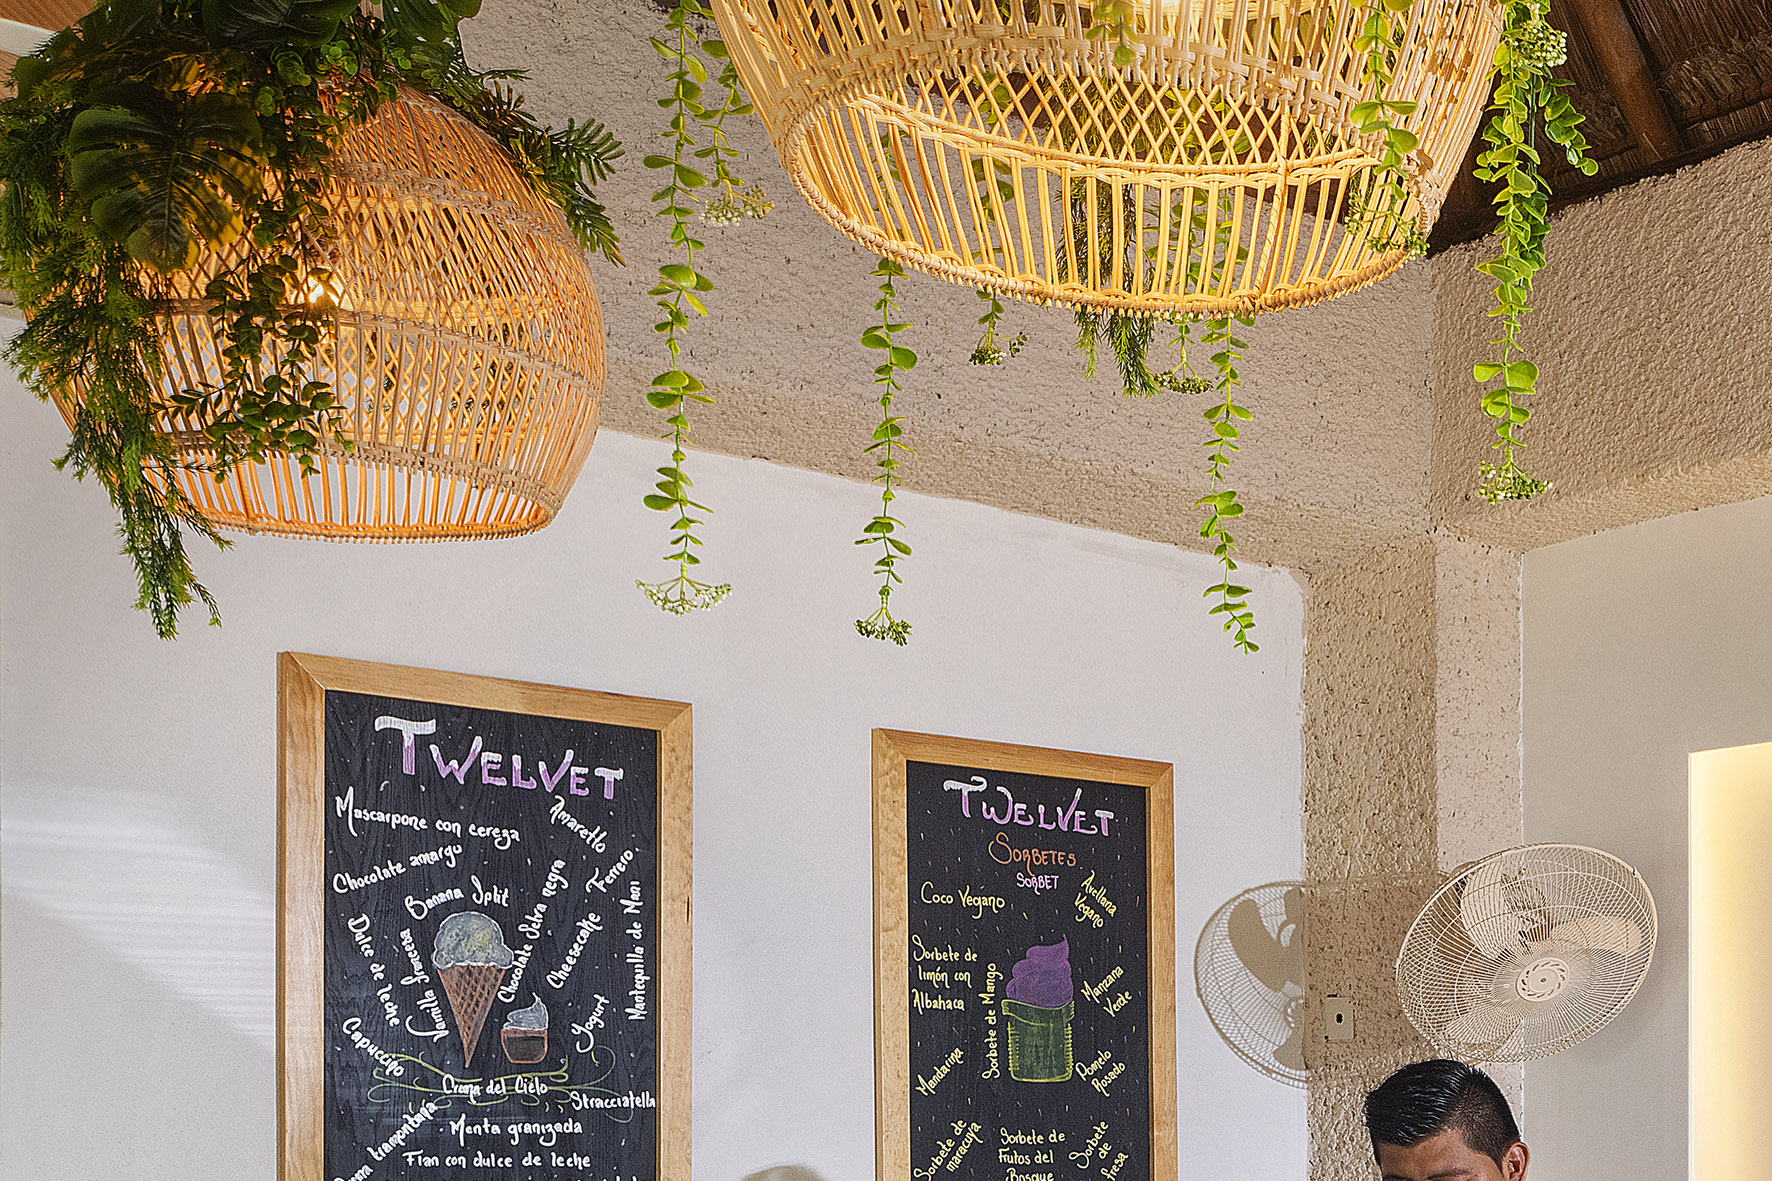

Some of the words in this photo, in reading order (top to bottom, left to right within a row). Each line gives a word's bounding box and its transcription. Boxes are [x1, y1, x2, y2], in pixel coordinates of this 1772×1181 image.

[375, 716, 623, 800] TWELVET
[335, 786, 428, 837] Mascarpone
[435, 819, 461, 838] con
[549, 795, 607, 853] Amaretto
[943, 776, 1114, 836] TWELVET
[333, 860, 406, 894] Chocolate
[585, 850, 634, 893] Ferrero
[1016, 872, 1059, 895] SORBET
[404, 888, 464, 920] Banana
[471, 874, 509, 907] Split
[921, 881, 954, 904] Coco
[958, 885, 1005, 919] Vegano
[1074, 892, 1104, 929] Vegano
[1081, 869, 1117, 917] Avellana
[347, 913, 374, 957] Dulce
[497, 944, 533, 1003] Chocolate
[518, 903, 548, 939] Selva
[541, 859, 568, 897] negra
[625, 921, 642, 940] de
[912, 934, 960, 961] Sorbete
[964, 947, 978, 961] de
[546, 912, 603, 989] Cheesecake
[370, 962, 385, 981] de
[624, 945, 650, 1020] Mantequilla
[954, 972, 972, 988] con
[978, 963, 1003, 1005] Mango
[1081, 966, 1124, 1004] Manzana
[377, 983, 400, 1027] leche
[912, 988, 965, 1015] Albahaca
[985, 1009, 997, 1025] de
[1103, 991, 1132, 1017] Verde
[571, 993, 610, 1053] Yogurt
[915, 1047, 964, 1096] Mandarina
[981, 1029, 1000, 1079] Sorbete
[1075, 1050, 1111, 1081] Pomelo
[442, 1074, 481, 1103] Crema
[486, 1077, 506, 1095] del
[515, 1075, 548, 1095] Cielo
[1091, 1062, 1126, 1097] Rosado
[449, 1113, 501, 1147] Menta
[950, 1120, 967, 1136] de
[1000, 1127, 1044, 1145] Sorbete
[1048, 1129, 1065, 1143] de
[1068, 1121, 1109, 1169] Sorbete
[445, 1156, 466, 1169] con
[473, 1150, 513, 1168] dulce
[522, 1151, 542, 1167] de
[551, 1152, 591, 1170] leche
[998, 1147, 1031, 1165] Frutos
[1034, 1149, 1054, 1164] del
[1098, 1142, 1112, 1159] de
[1100, 1152, 1128, 1181] fresa
